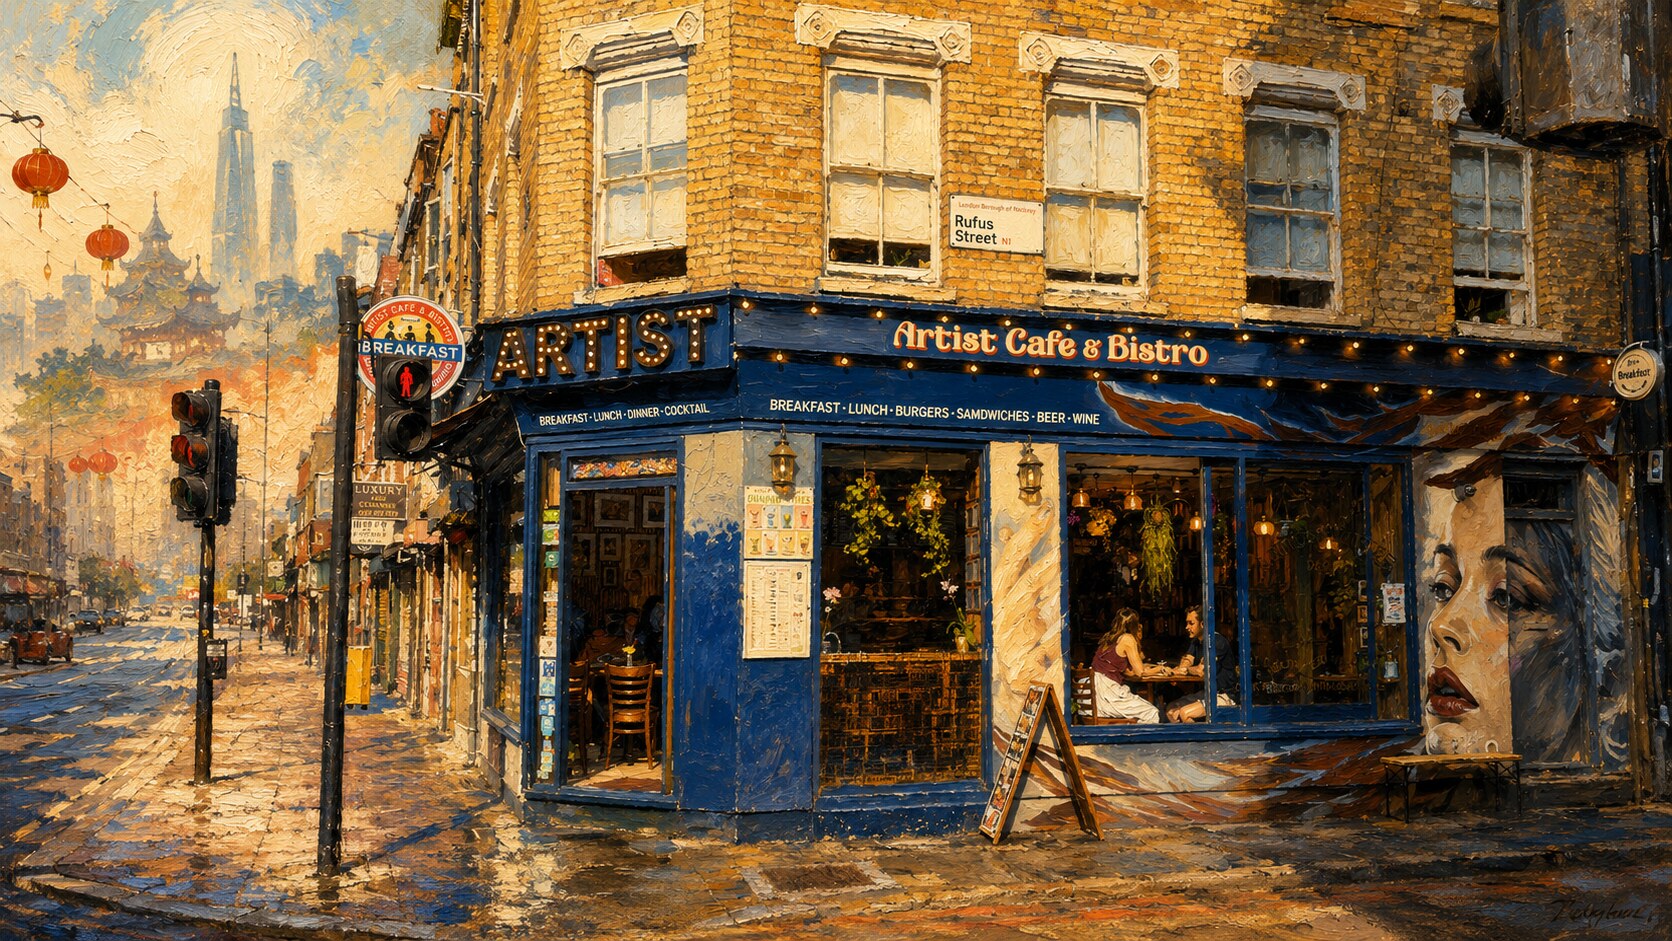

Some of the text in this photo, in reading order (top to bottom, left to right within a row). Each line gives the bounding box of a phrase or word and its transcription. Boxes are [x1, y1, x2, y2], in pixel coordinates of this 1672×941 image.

[955, 214, 994, 230] Rufus
[955, 229, 998, 245] Street
[362, 340, 459, 360] BREAKFAST
[491, 303, 718, 382] ARTIST
[893, 320, 1210, 366] Artist Cafe & Bistro
[539, 402, 710, 426] BREAKFAST LUNCH DINNER COCKTAIL
[769, 399, 841, 414] BREAKFAST
[848, 403, 888, 416] LUNCH
[895, 405, 949, 419] BURGERS
[1036, 411, 1066, 424] BEER
[1072, 413, 1100, 425] WINE
[355, 485, 403, 496] LUXURY
